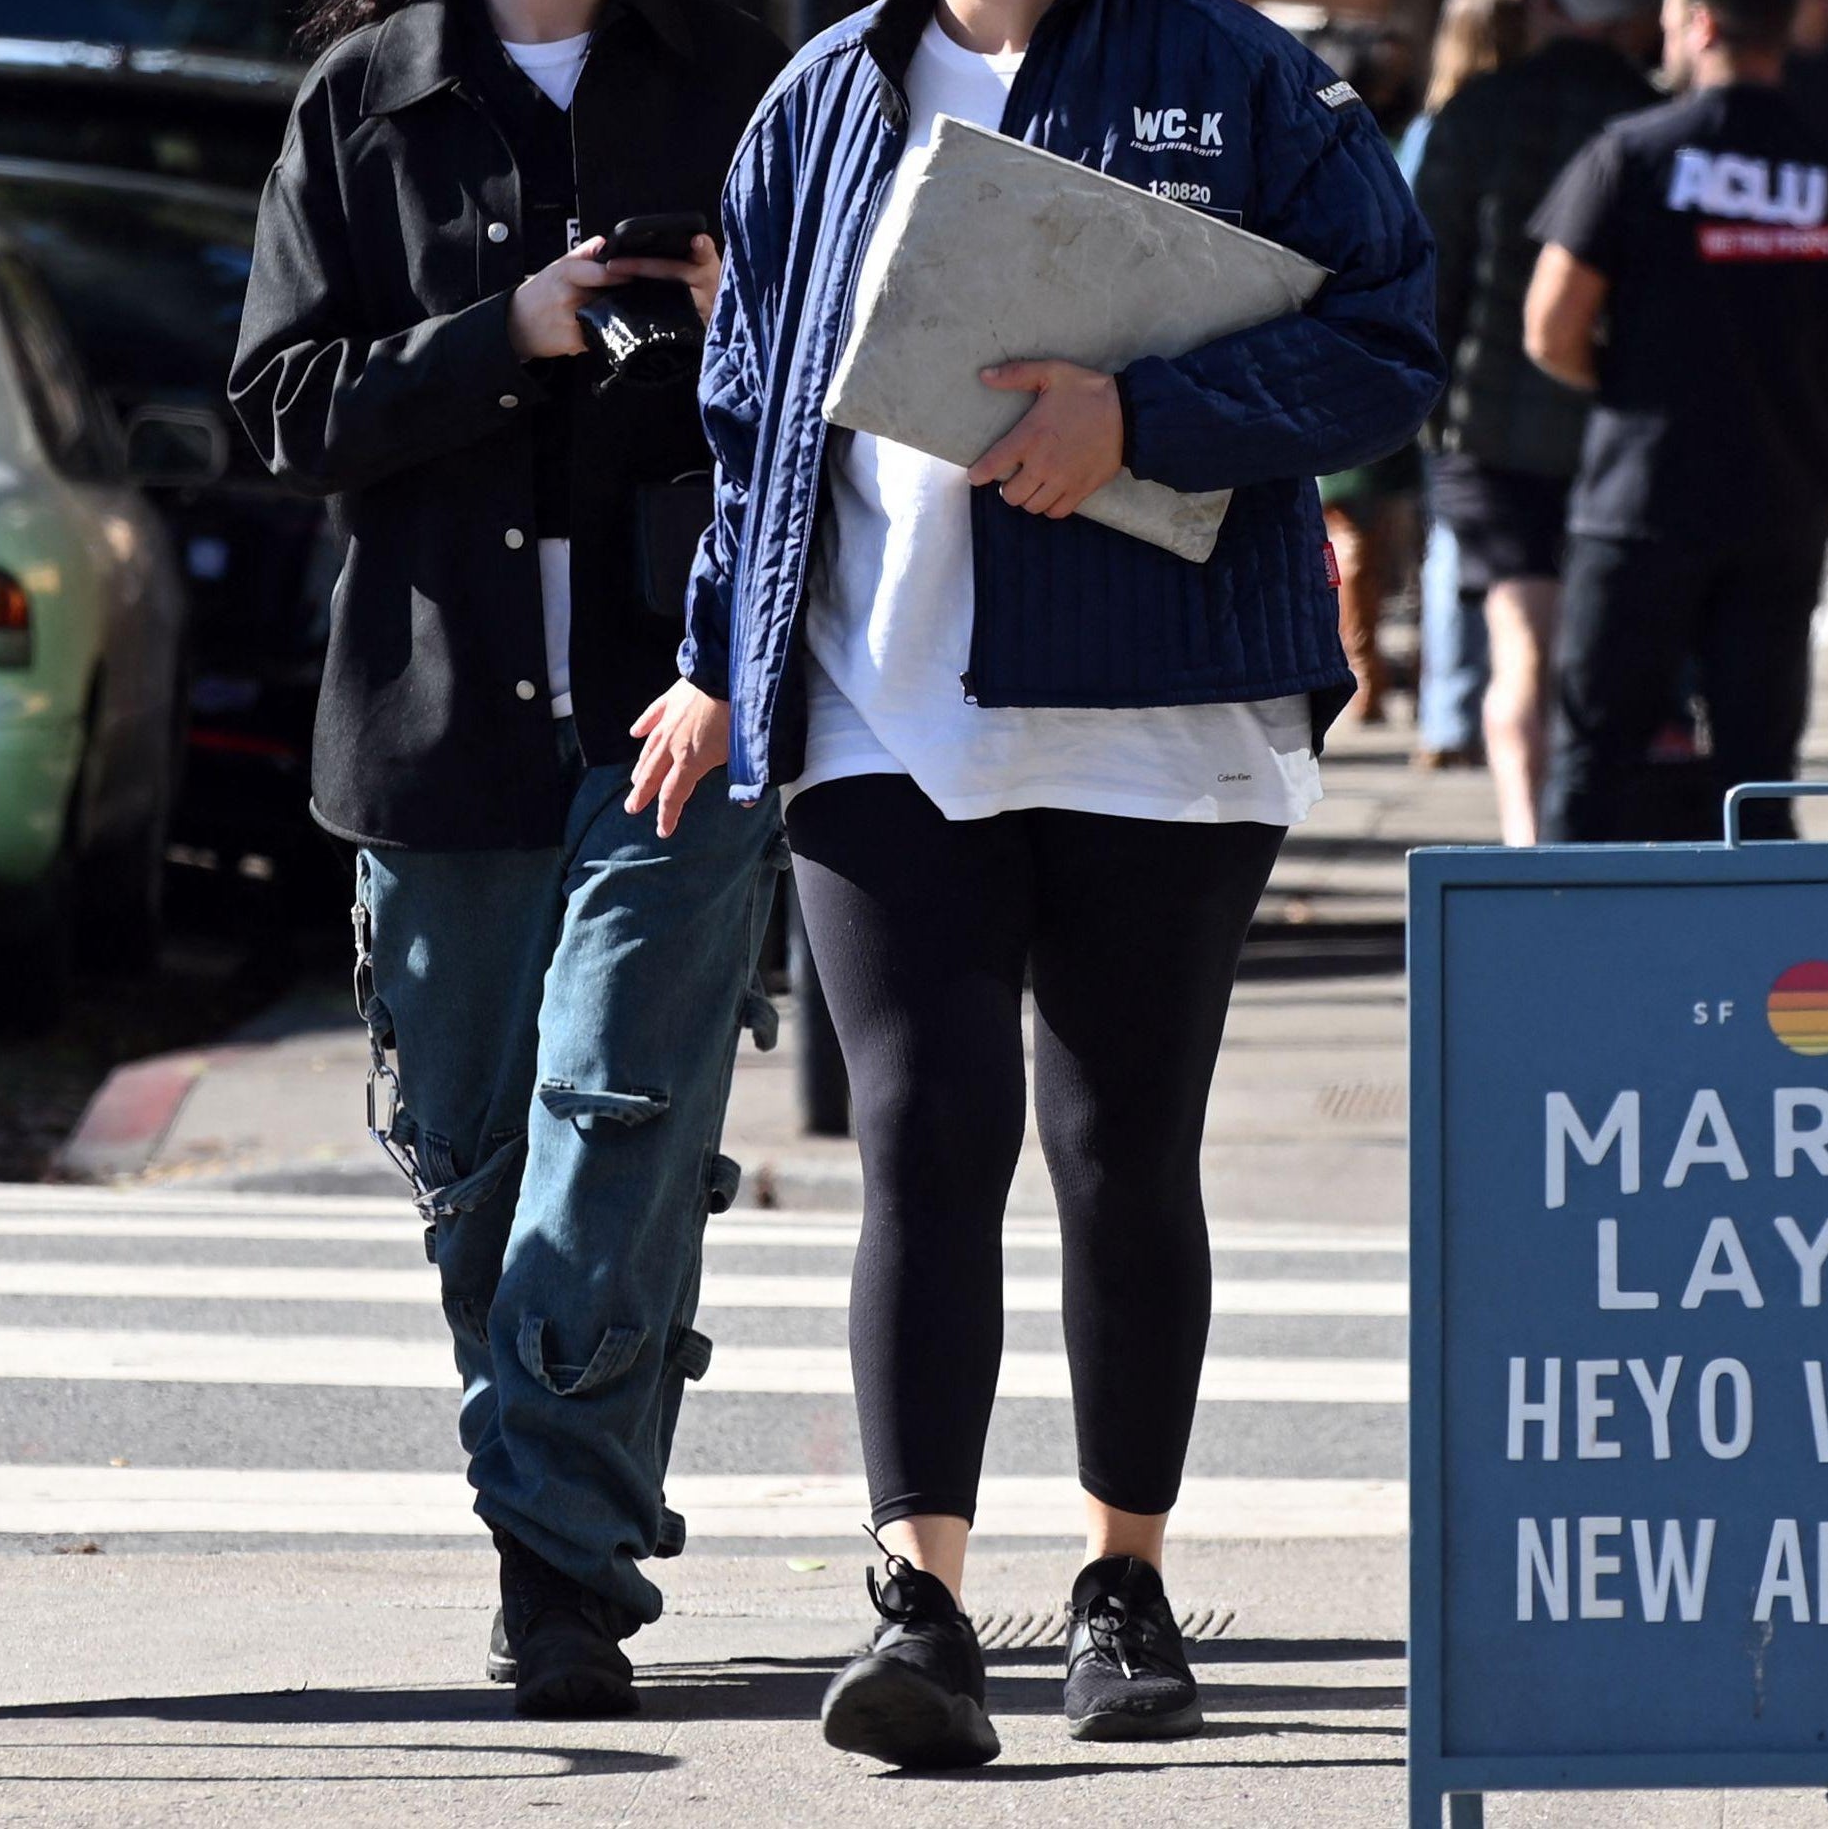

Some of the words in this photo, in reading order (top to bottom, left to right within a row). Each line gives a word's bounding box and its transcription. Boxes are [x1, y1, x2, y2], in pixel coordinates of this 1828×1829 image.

[1133, 106, 1223, 146] WC-K
[1148, 180, 1211, 204] 130820
[1668, 147, 1828, 226] ACLU
[1507, 1355, 1754, 1462] HEYO
[1516, 1516, 1717, 1623] NEW
